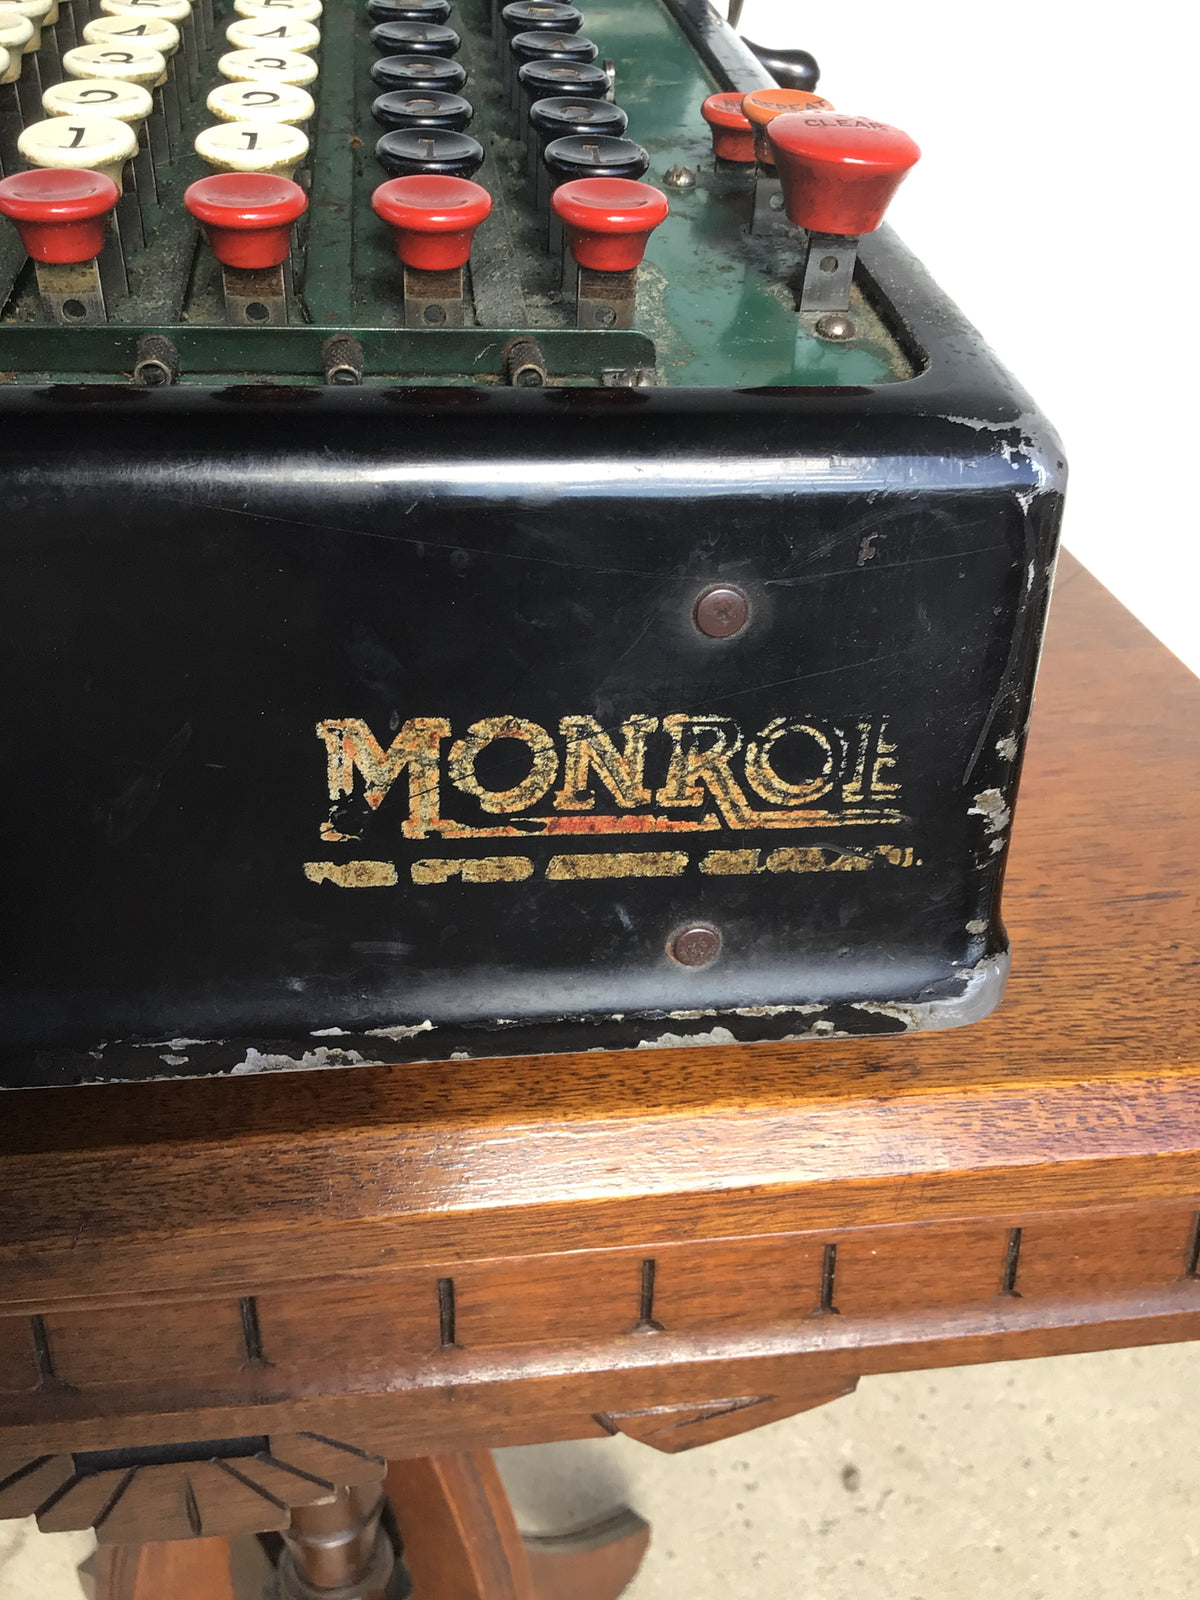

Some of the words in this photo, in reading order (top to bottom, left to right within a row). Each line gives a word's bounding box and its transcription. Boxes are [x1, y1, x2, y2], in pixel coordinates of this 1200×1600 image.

[112, 23, 148, 36] 4
[256, 26, 288, 38] 4
[92, 51, 134, 64] 3
[247, 57, 288, 70] 3
[76, 89, 119, 104] 2
[242, 91, 281, 107] 2
[804, 119, 887, 131] CLEAR
[59, 127, 87, 149] 1
[237, 132, 260, 151] 1
[417, 138, 437, 159] 1
[582, 144, 603, 164] 1
[314, 713, 903, 842] MONROE
